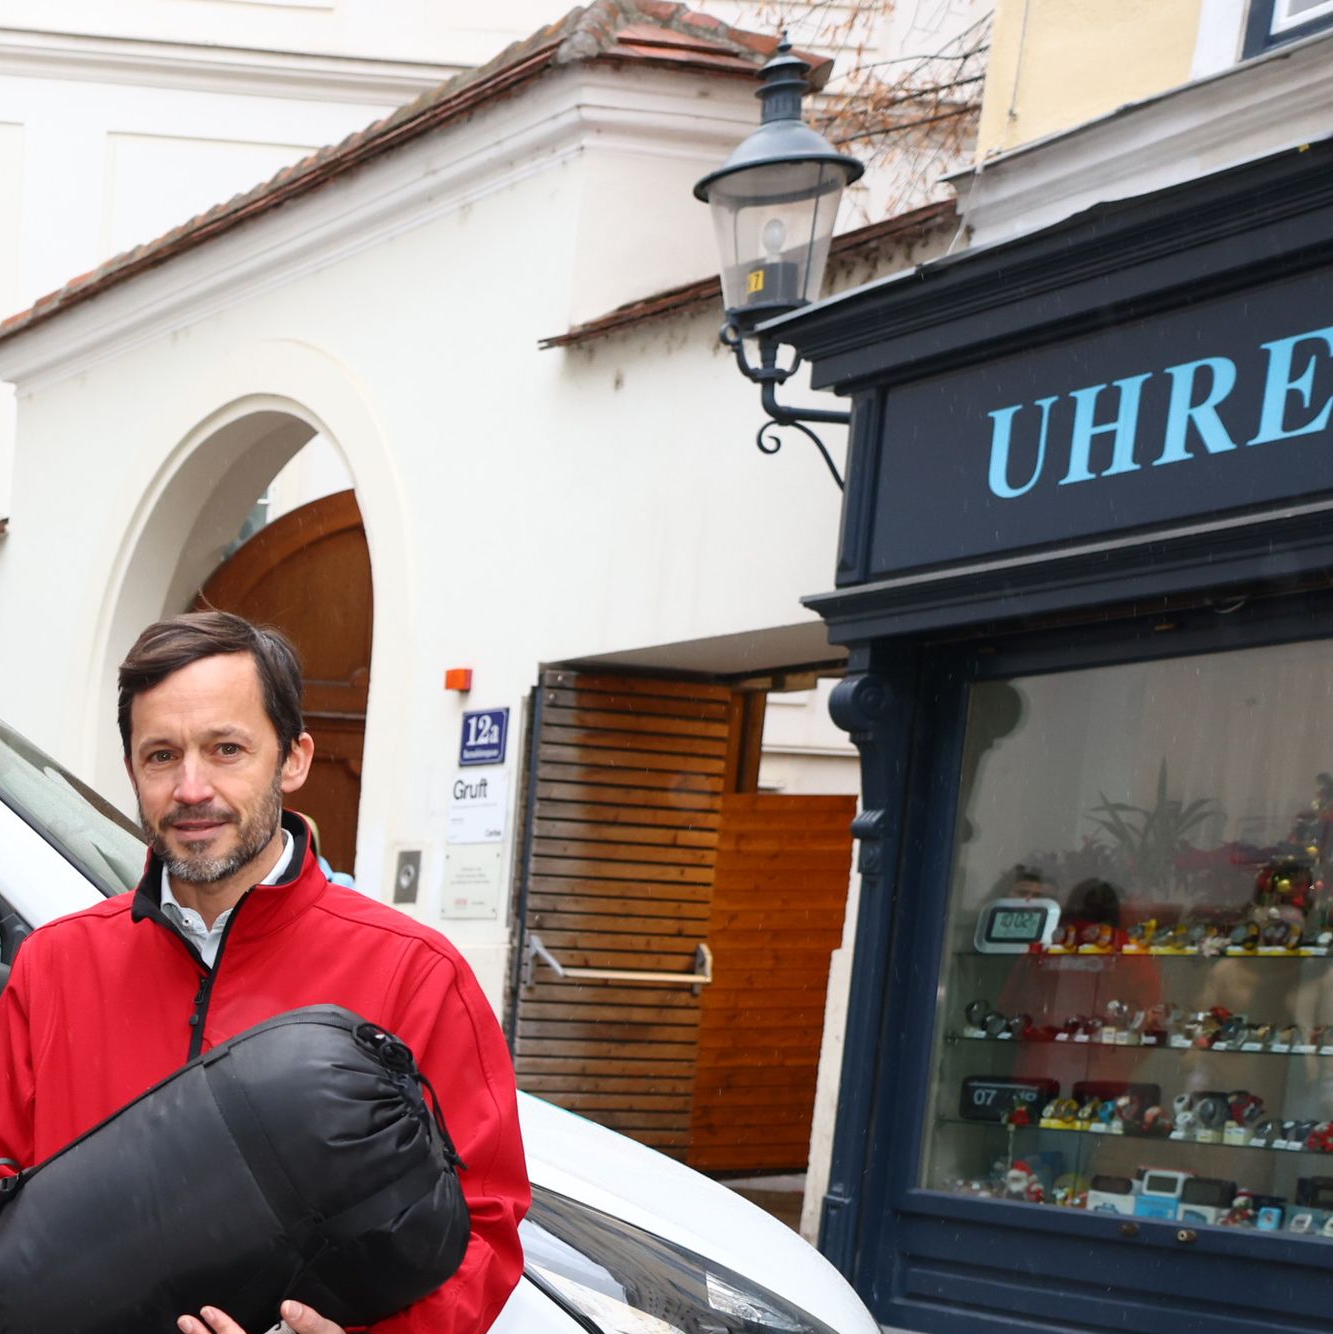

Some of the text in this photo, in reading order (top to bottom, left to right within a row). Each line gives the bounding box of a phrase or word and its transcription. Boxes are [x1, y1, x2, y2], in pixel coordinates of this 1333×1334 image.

[987, 325, 1333, 499] UHRE
[465, 714, 500, 746] 12a
[453, 777, 488, 800] Gruft
